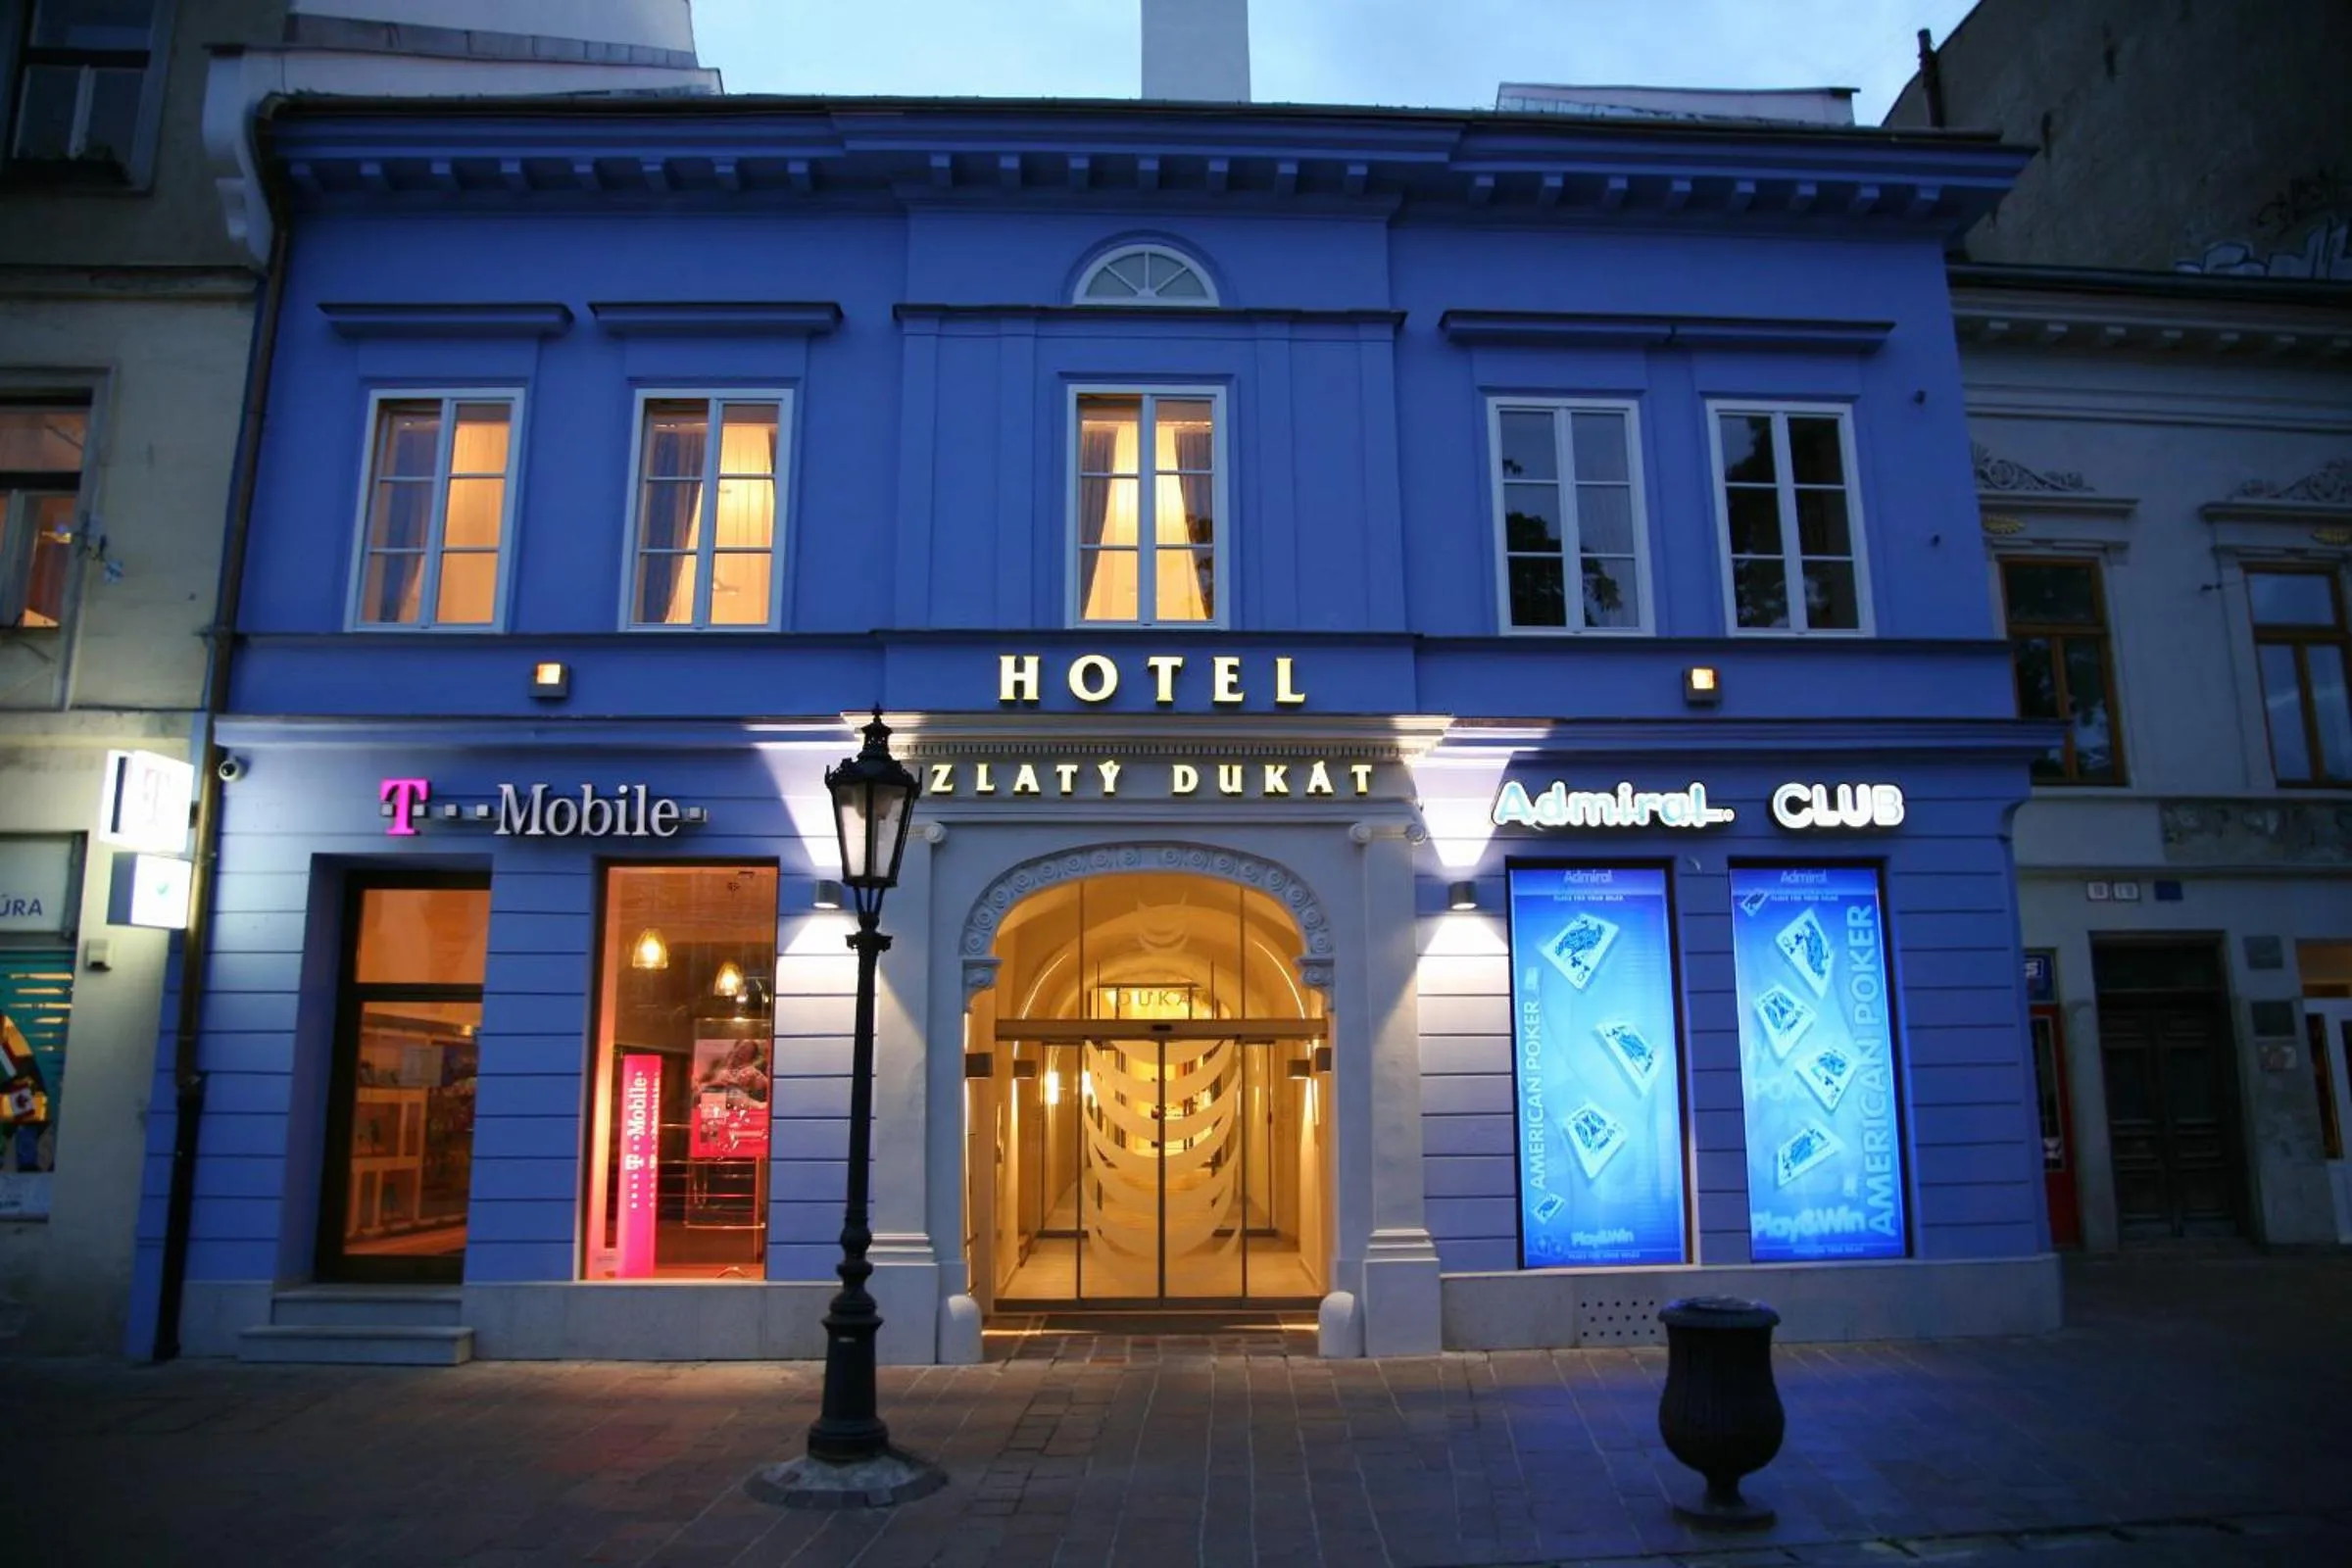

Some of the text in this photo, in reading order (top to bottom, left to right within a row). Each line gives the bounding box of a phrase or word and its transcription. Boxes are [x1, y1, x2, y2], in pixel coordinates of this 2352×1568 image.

[999, 654, 1306, 704] HOTEL
[930, 759, 1373, 795] ZLATÝ DUKÁT
[1772, 782, 1906, 830] CLUB
[1524, 1001, 1543, 1070] POKER
[1846, 905, 1897, 1238] AMERICAN POKER
[1527, 1077, 1545, 1190] AMERICAN
